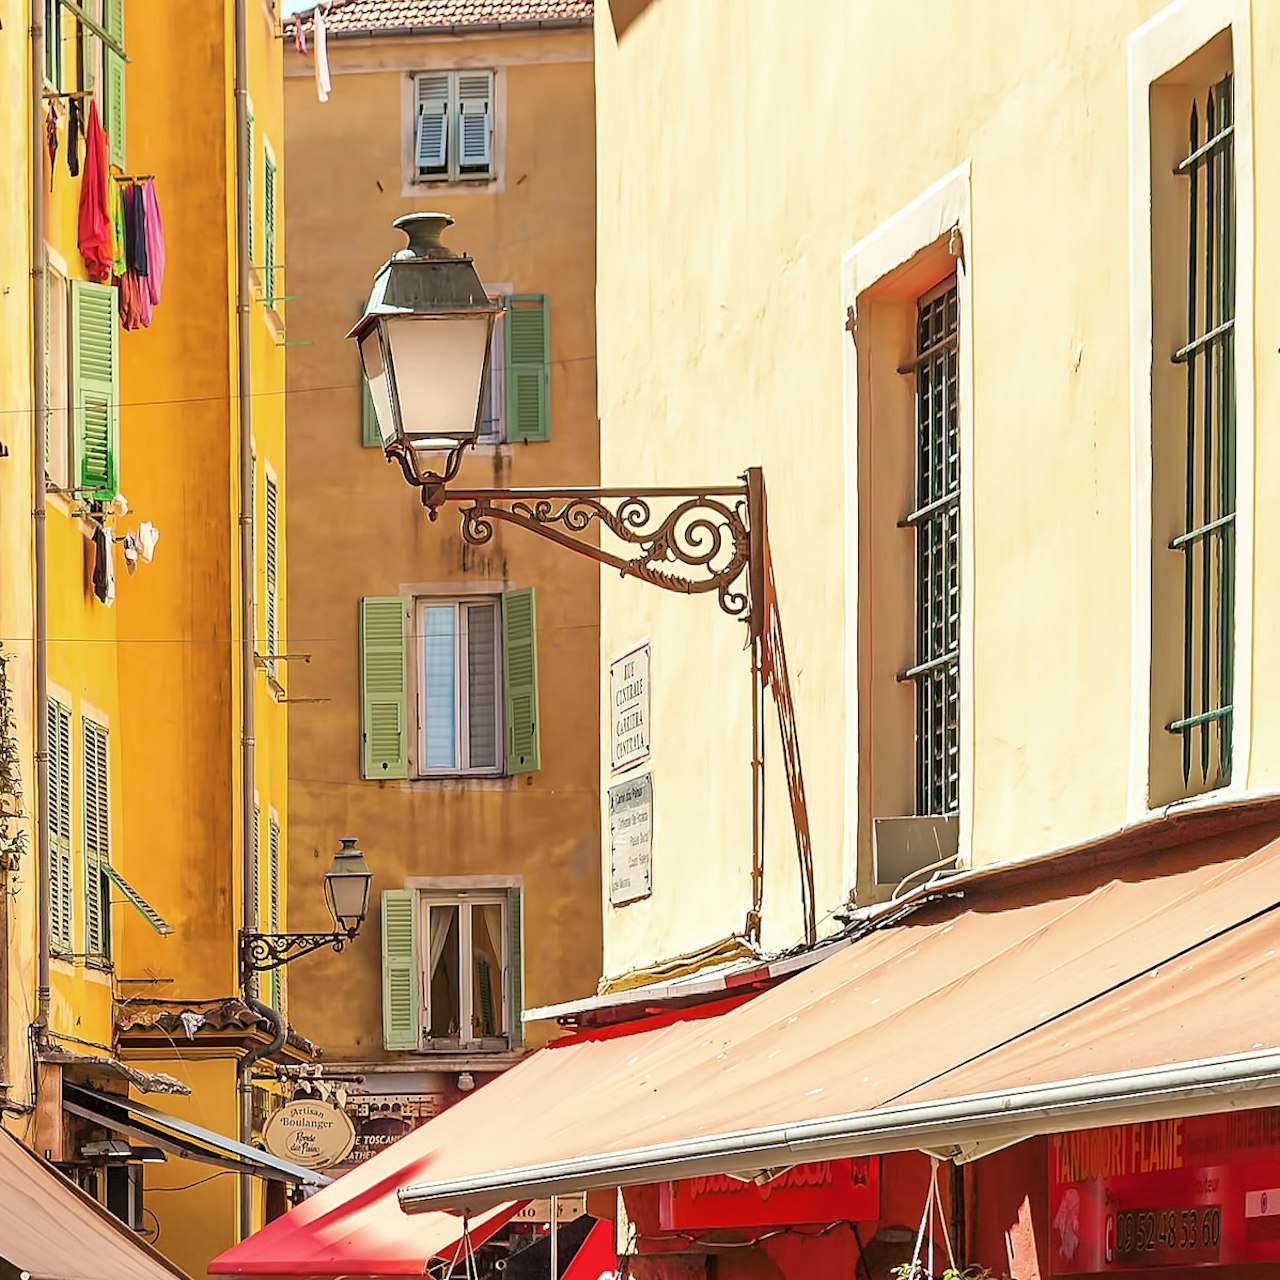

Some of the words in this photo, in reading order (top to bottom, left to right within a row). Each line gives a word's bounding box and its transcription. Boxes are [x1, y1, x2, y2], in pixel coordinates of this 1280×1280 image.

[280, 1117, 334, 1130] Boulanger
[290, 1106, 325, 1120] Artisan
[1130, 1118, 1184, 1175] FLAME
[1136, 1211, 1155, 1252] 52
[1158, 1210, 1176, 1249] 48
[1180, 1208, 1197, 1249] 53
[1201, 1206, 1221, 1248] 60
